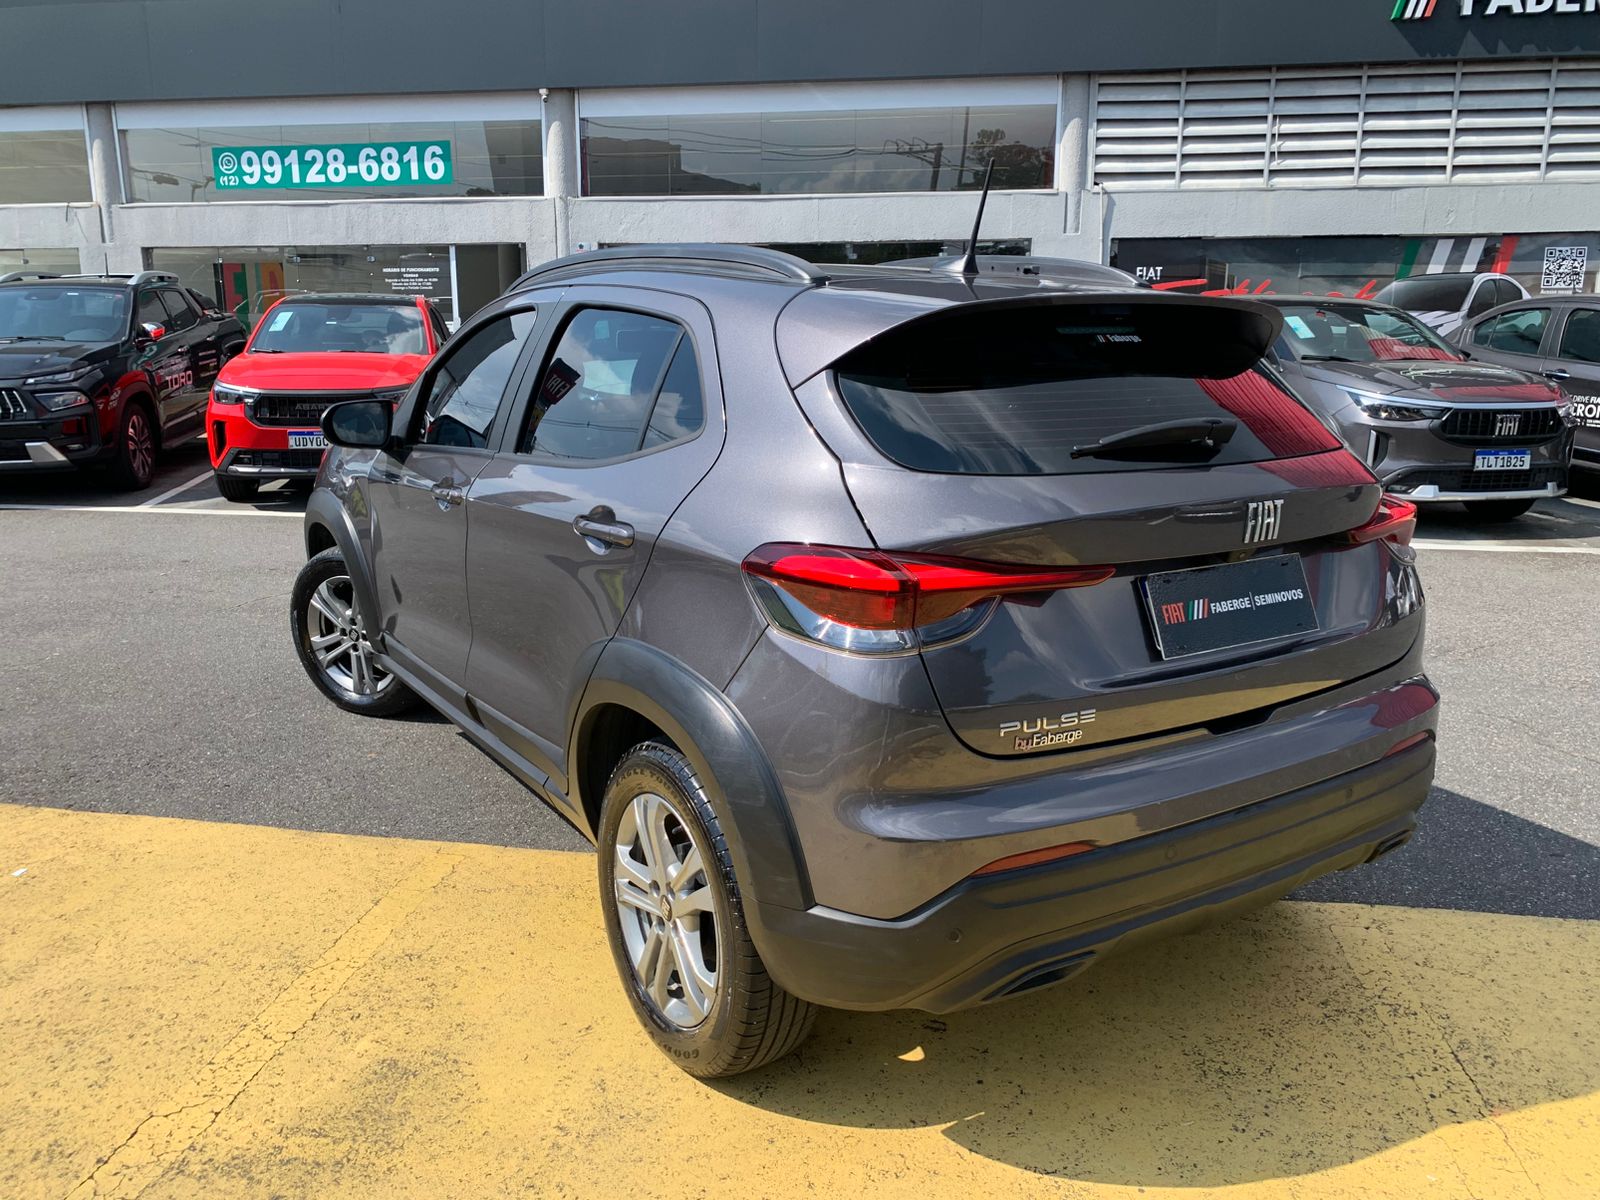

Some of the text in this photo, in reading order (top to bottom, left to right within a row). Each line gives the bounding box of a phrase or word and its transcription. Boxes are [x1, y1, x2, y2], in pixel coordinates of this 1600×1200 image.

[240, 145, 445, 185] 99128-6816
[219, 175, 238, 186] (12)
[1136, 266, 1163, 280] FIAT
[165, 370, 193, 391] TORO
[1494, 414, 1521, 436] FIAT
[1481, 456, 1525, 469] TLT1B25
[1244, 499, 1284, 544] FIAT
[1161, 588, 1304, 625] FIAT FABERGE SEMINOVOS
[1000, 708, 1097, 737] PULSE
[1032, 729, 1083, 748] Faberge
